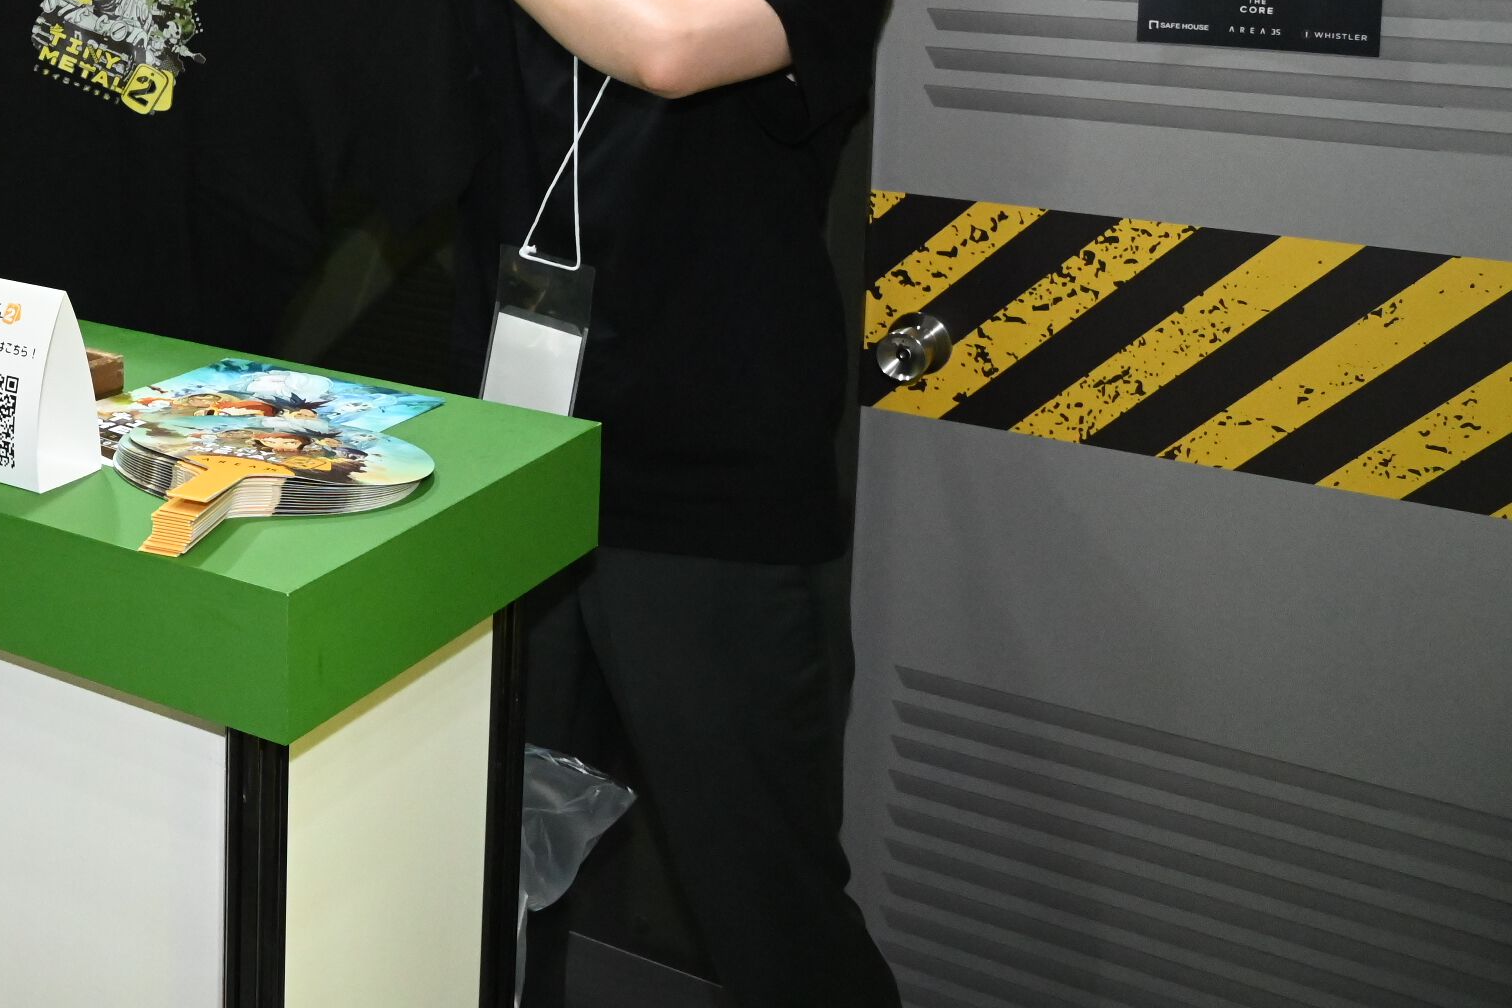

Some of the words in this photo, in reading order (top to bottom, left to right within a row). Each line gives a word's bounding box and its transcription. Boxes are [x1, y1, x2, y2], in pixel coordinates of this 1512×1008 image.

[1240, 5, 1274, 15] CORE
[1182, 23, 1209, 31] HOUSE
[1314, 31, 1368, 42] WHISTLER
[38, 46, 124, 94] METAL
[127, 75, 158, 107] 2
